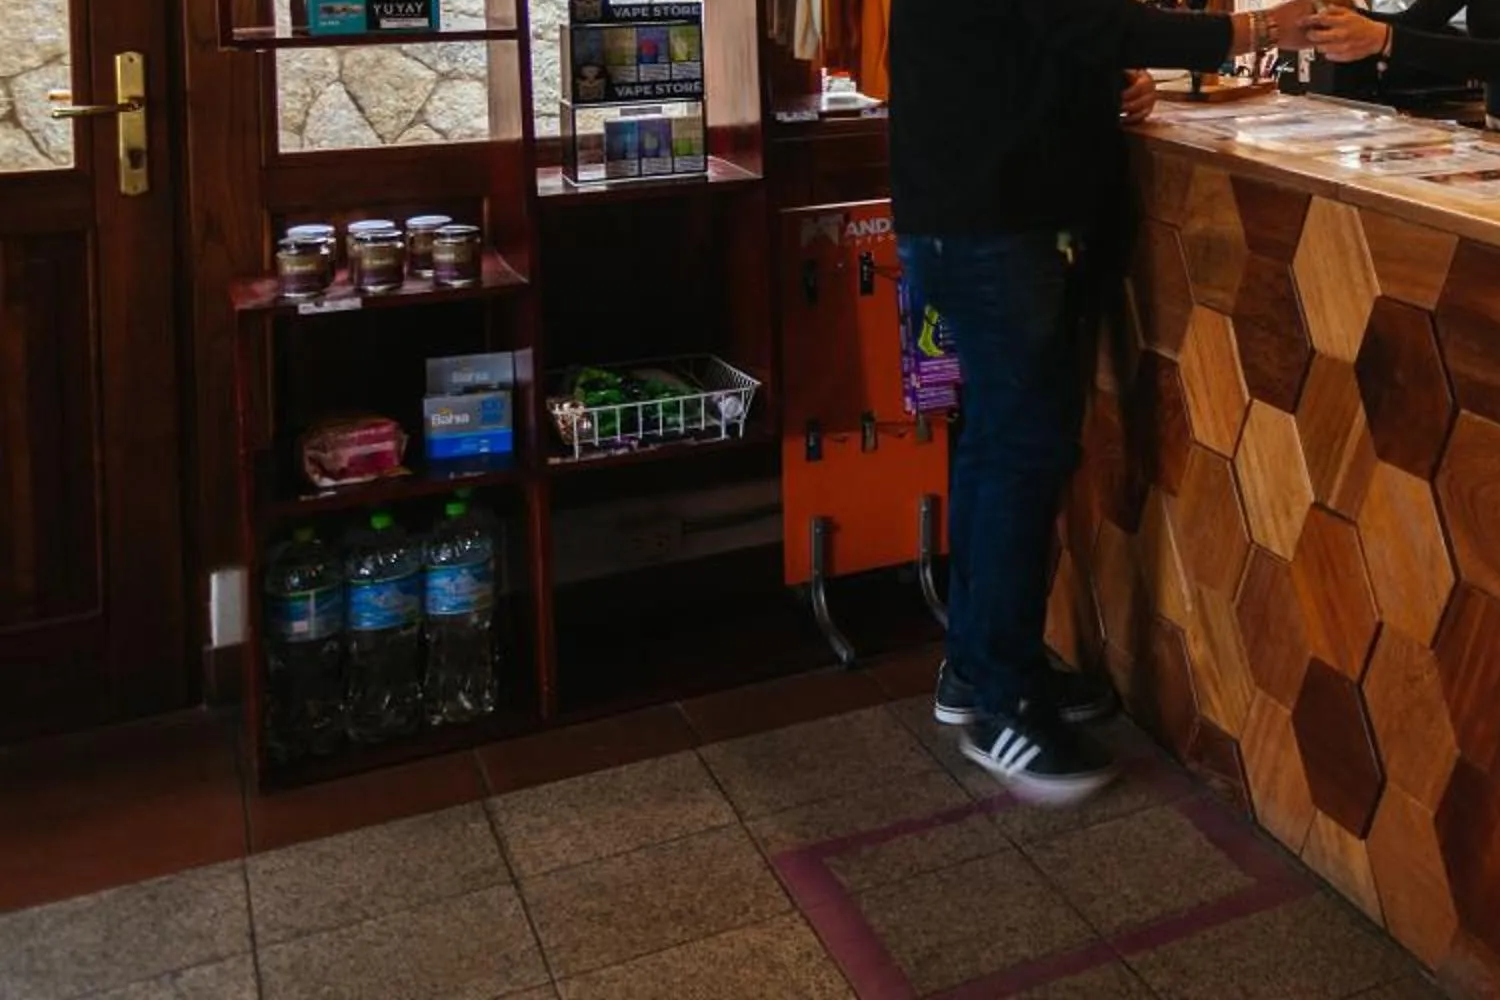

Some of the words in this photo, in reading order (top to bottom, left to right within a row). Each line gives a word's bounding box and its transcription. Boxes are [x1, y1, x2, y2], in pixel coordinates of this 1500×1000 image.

[373, 2, 424, 16] YUYAY
[613, 7, 650, 18] VAPE
[654, 5, 701, 16] STORE
[615, 85, 651, 97] VAPE
[655, 82, 702, 95] STORE
